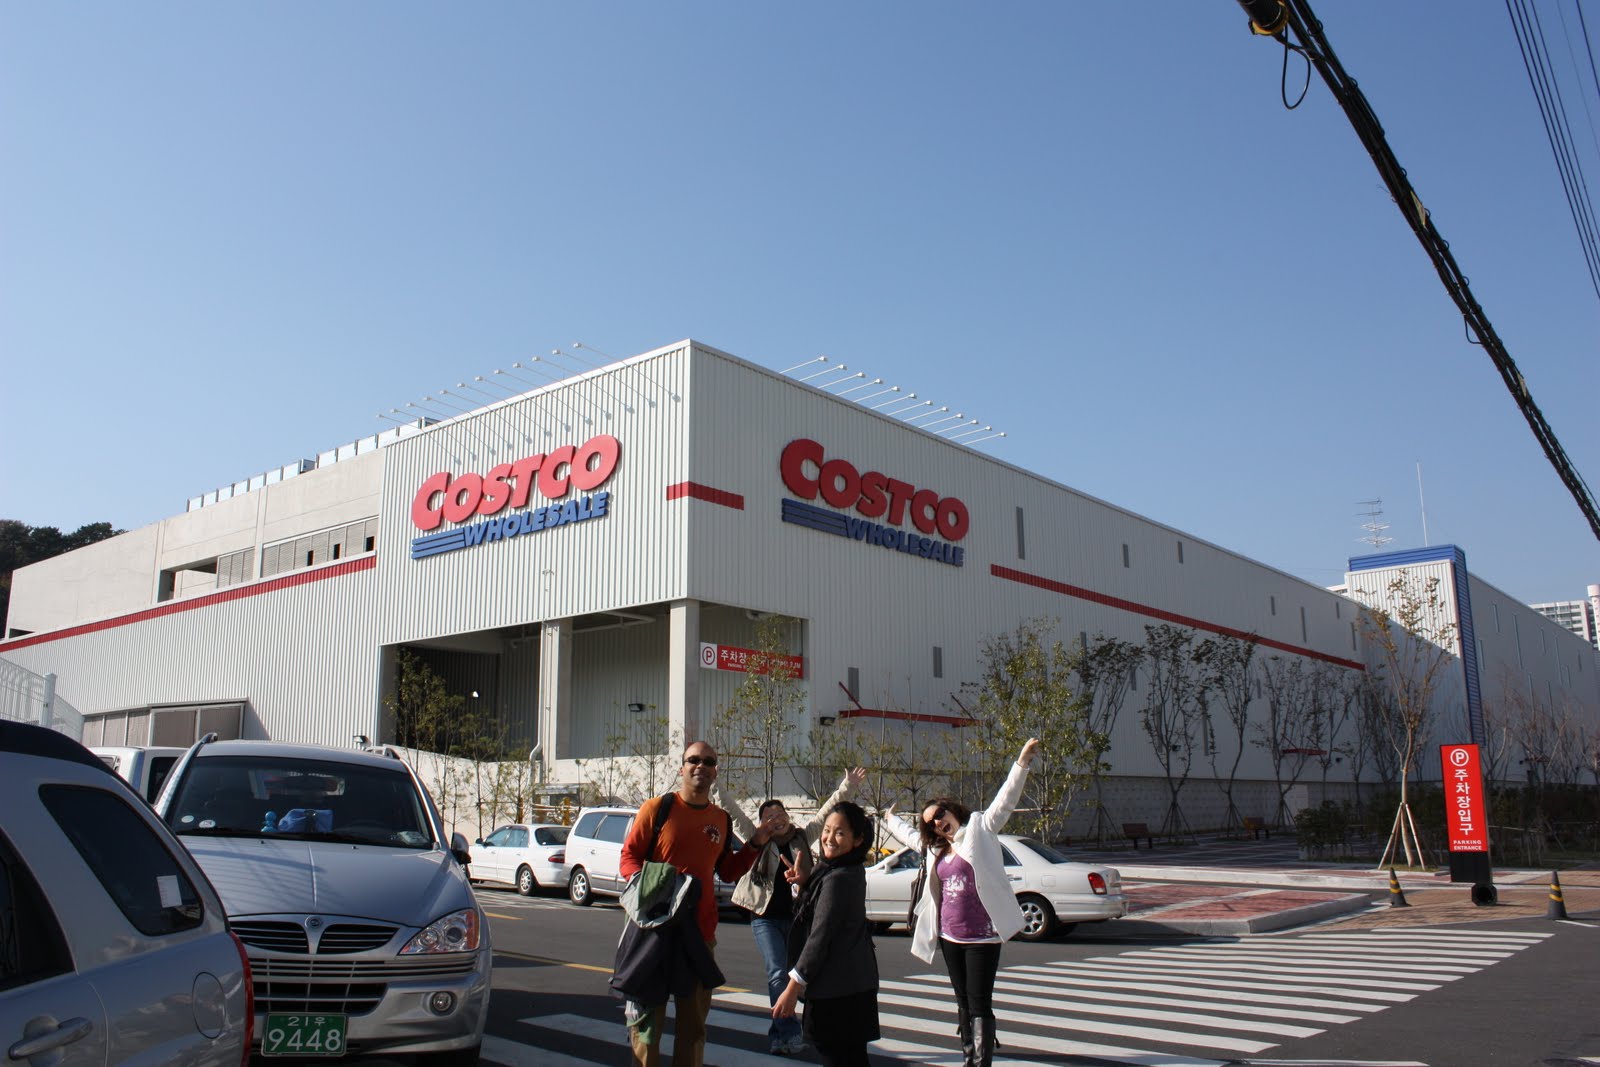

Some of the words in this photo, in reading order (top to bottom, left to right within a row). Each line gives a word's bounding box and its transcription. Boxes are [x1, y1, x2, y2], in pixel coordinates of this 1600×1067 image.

[412, 434, 620, 530] COSTCO
[780, 439, 970, 541] COSTCO
[463, 491, 609, 547] WHOLESALE
[846, 516, 965, 567] WHOLESALE
[721, 650, 746, 664] 주차장
[1454, 769, 1474, 835] 주차장입구
[268, 1028, 341, 1051] 9448
[288, 1016, 326, 1026] 21우
